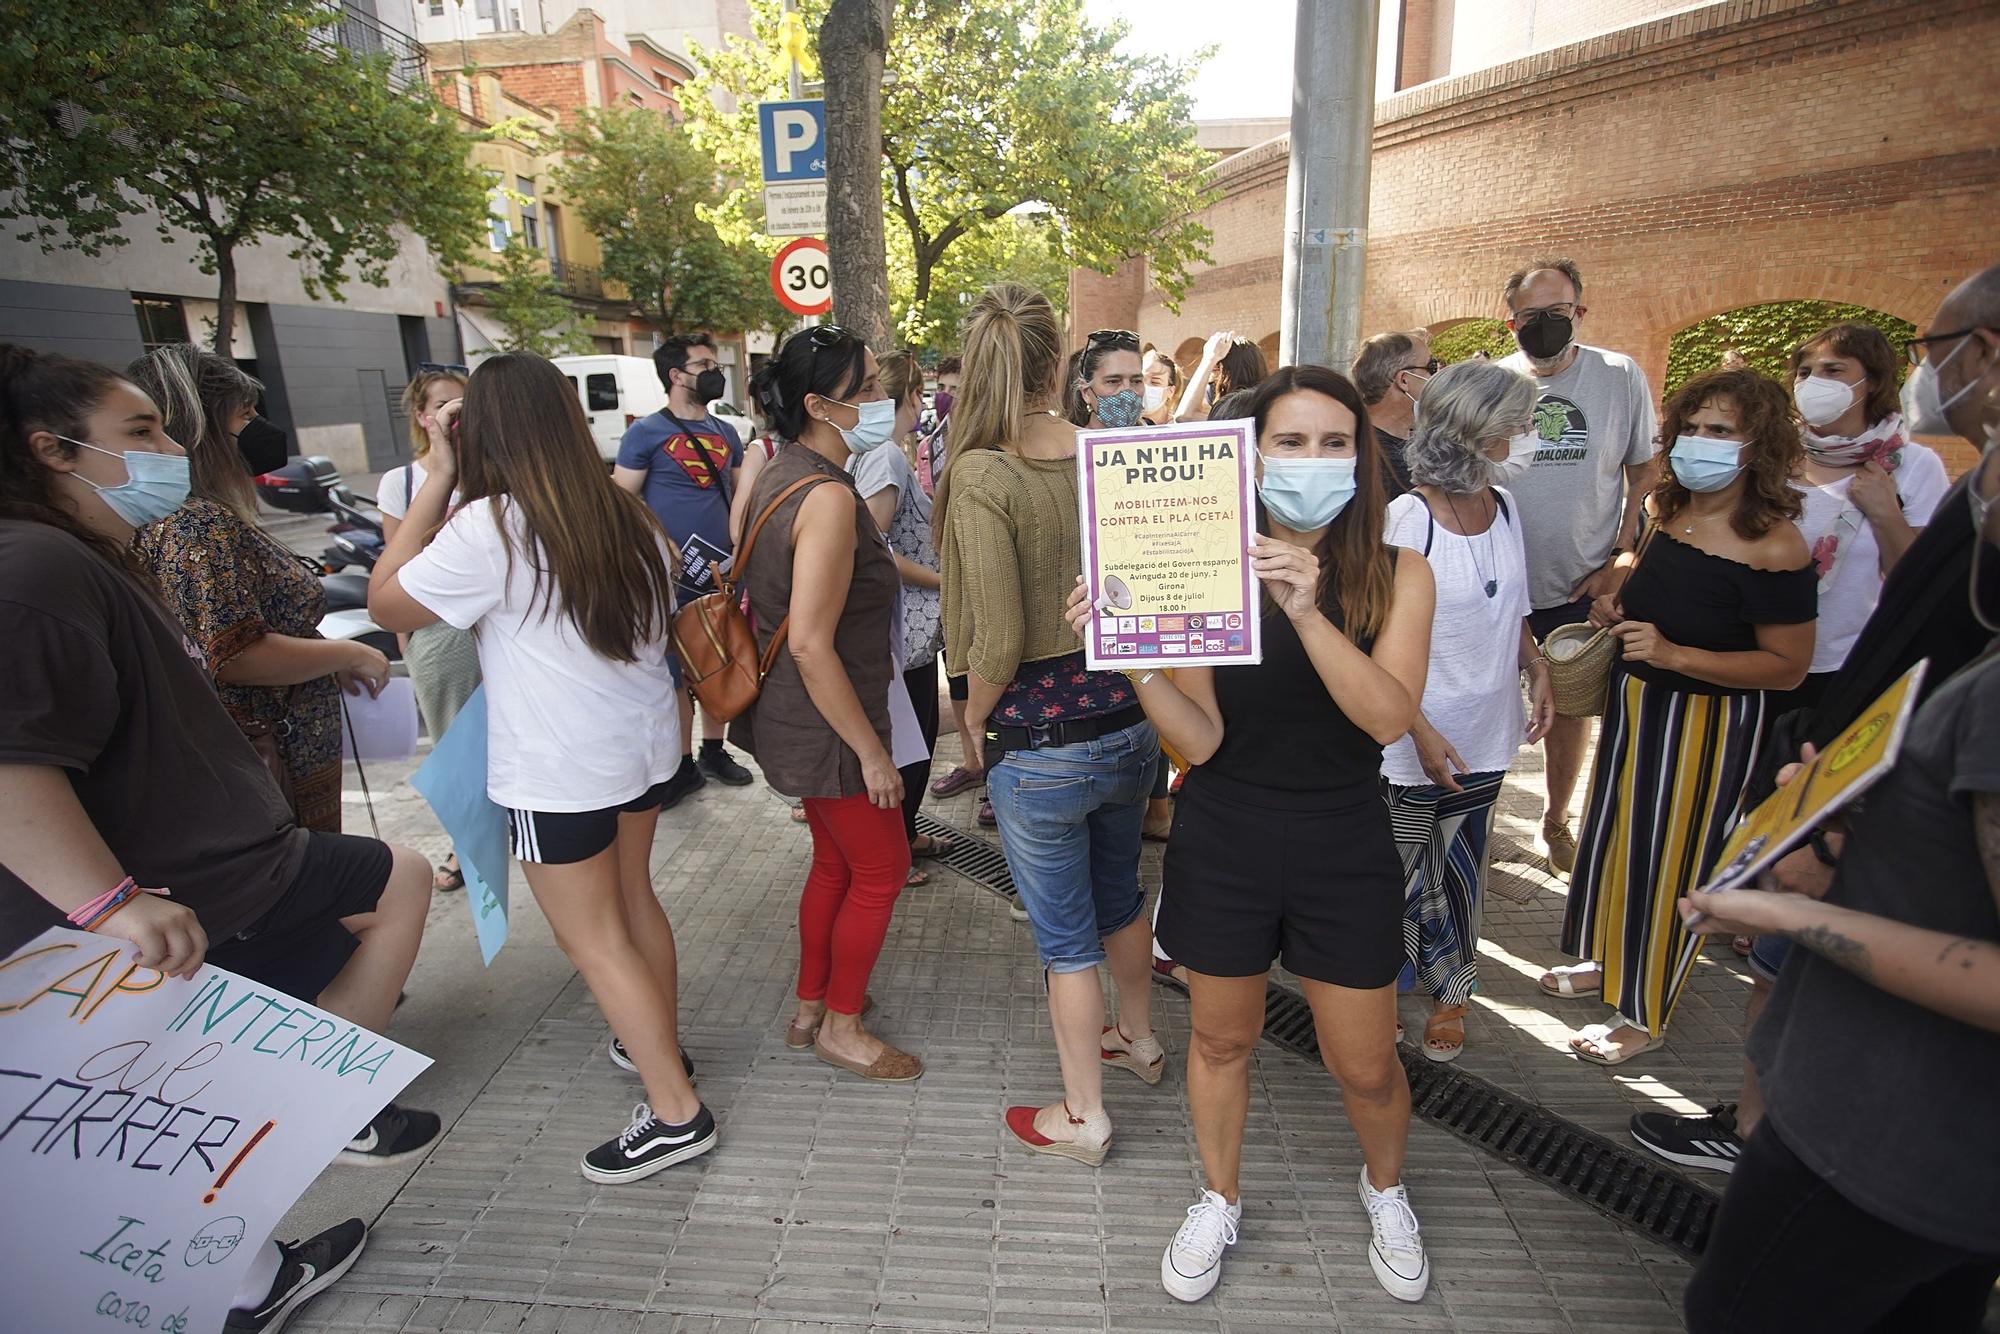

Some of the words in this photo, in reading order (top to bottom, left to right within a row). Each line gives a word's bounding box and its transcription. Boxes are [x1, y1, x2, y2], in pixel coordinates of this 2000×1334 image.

[773, 109, 818, 173] P
[787, 265, 829, 291] 30
[1096, 450, 1126, 467] JA
[1137, 446, 1187, 465] N'HI
[1199, 443, 1234, 460] HA
[1126, 464, 1203, 485] PROU!
[1114, 496, 1218, 511] MOBILITZEM-NOS
[1100, 516, 1149, 527] CONTRA
[1153, 515, 1165, 524] EL
[1169, 514, 1191, 523] PLA
[1195, 511, 1234, 522] ICETA!
[1104, 561, 1156, 571] Subdelegació
[1171, 560, 1201, 568] Govern
[1203, 558, 1239, 567] espanyol
[1130, 572, 1166, 581] Avinguda
[1140, 594, 1165, 602] Dijous
[1184, 592, 1205, 601] juliol
[0, 943, 168, 1024] CAP
[166, 974, 395, 1084] INTERINA
[80, 1215, 172, 1283] Iceta
[161, 1305, 190, 1334] de
